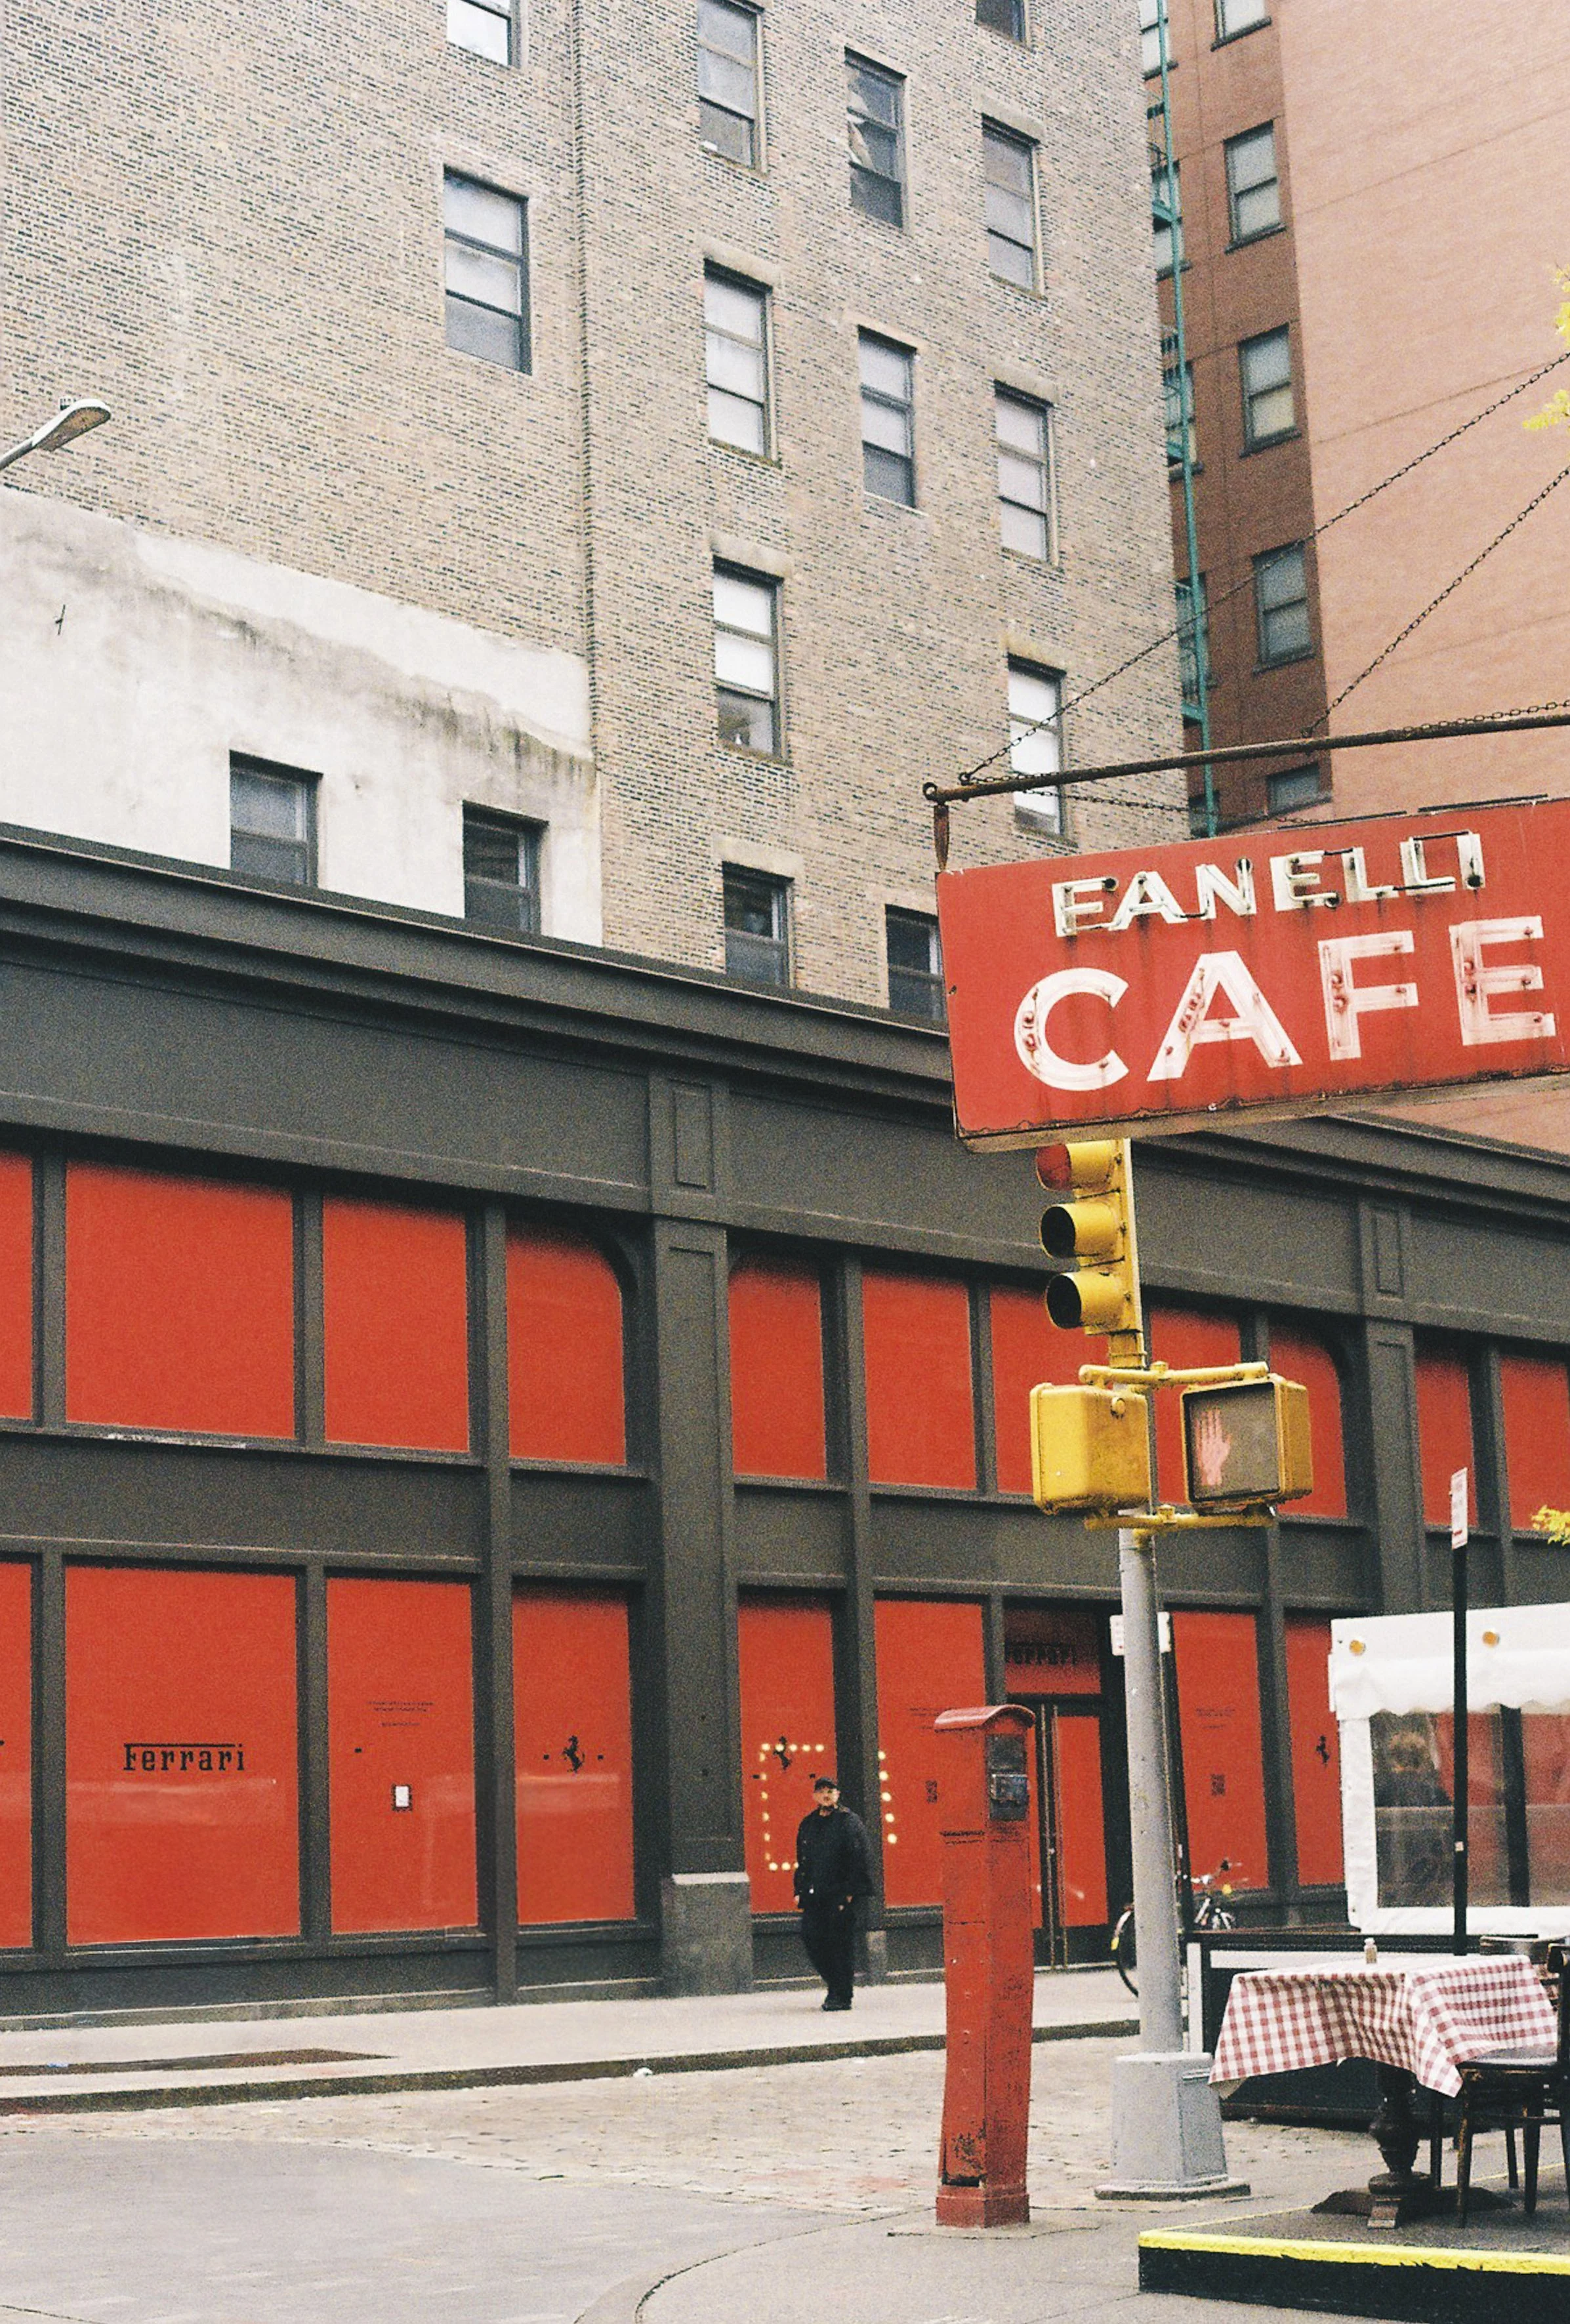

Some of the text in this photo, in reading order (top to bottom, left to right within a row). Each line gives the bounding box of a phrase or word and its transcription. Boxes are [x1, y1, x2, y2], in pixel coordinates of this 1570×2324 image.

[1051, 830, 1485, 937] FANELLI
[1014, 915, 1556, 1091] CAFE
[123, 1743, 245, 1771] Ferrari
